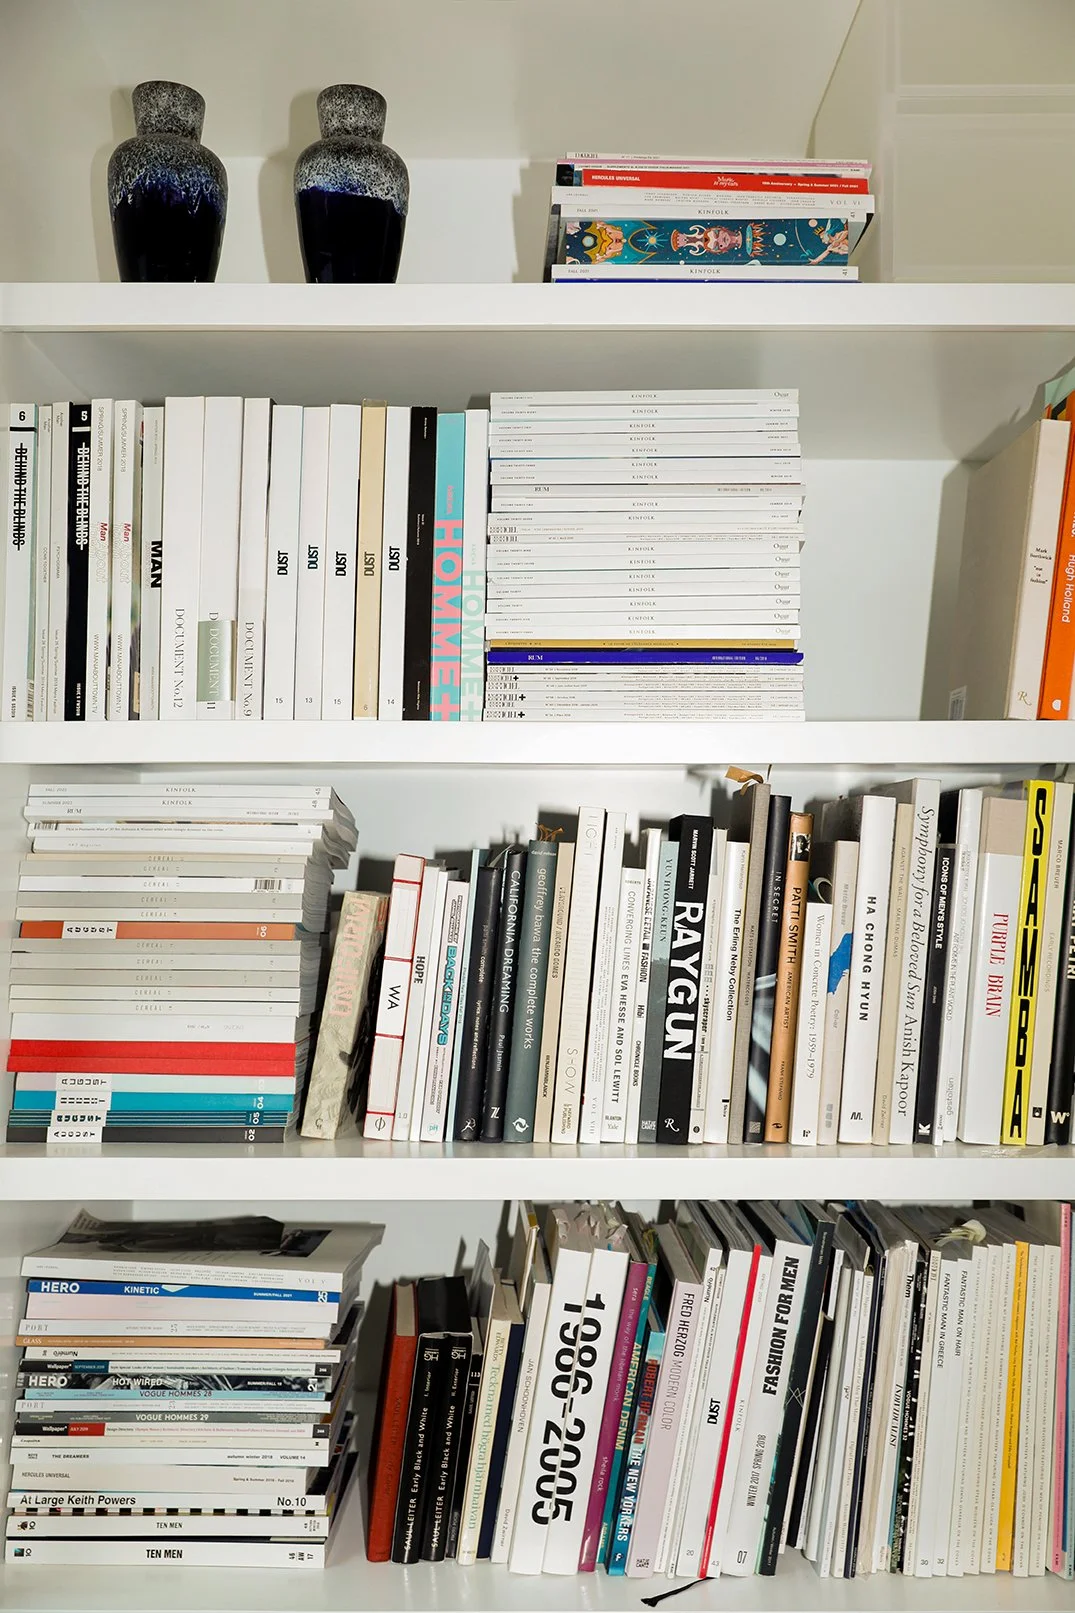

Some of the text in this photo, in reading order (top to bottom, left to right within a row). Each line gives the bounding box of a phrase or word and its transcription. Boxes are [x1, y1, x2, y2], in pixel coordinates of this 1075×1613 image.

[18, 411, 26, 421] 6
[81, 411, 88, 421] 5
[12, 447, 28, 546] BEHIND THE BLINDS
[75, 447, 90, 546] BEHIND THE BLINDS
[100, 522, 108, 541] Man
[150, 539, 163, 589] MAN
[277, 550, 288, 576] DUST
[307, 545, 319, 570] DUST
[335, 551, 347, 576] DUST
[363, 551, 375, 576] DUST
[388, 546, 400, 571] DUST
[1062, 554, 1075, 623] Hugh Holland
[173, 608, 185, 708] DOCUMENT No.12
[244, 622, 254, 689] DOCUMENT
[687, 828, 700, 891] MARVIN SCOTT JARRETT
[659, 859, 673, 942] YUN HYONG-KEUN
[771, 871, 783, 922] IN SECRET
[935, 855, 950, 950] ICONS OF MEN'S STYLE
[259, 926, 267, 937] 06
[784, 885, 804, 965] PATTI SMITH
[815, 915, 825, 946] Women
[497, 868, 523, 1014] CALIFORNIA DREAMING
[523, 846, 548, 1050] geoffrey bawa the complete works
[814, 949, 820, 957] in
[412, 954, 426, 985] HOPE
[444, 946, 457, 992] BACK
[638, 952, 650, 983] FASHION
[726, 909, 742, 1021] The Erling Neby Collection
[859, 896, 877, 1021] HA CHONG HYUN
[895, 806, 935, 1117] Symphony for a Beloved Sun Anish Kapoor
[985, 913, 1009, 1017] PURPLE BRAIN
[663, 899, 706, 1062] RAYGUN
[811, 959, 822, 998] Concrete
[387, 985, 401, 1010] WA
[611, 891, 636, 1103] CONVERGING LINES EVA HESSE AND SOL LEWITT
[635, 1003, 646, 1020] Hibi
[781, 970, 793, 1030] AMERICAN ARTIST
[438, 1002, 451, 1046] DAYS
[807, 1000, 819, 1030] Poetry:
[257, 1096, 264, 1109] 04
[248, 1128, 256, 1141] 02
[41, 1282, 80, 1293] HERO
[124, 1286, 160, 1295] KINETIC
[905, 1274, 915, 1298] Them
[942, 1273, 951, 1311] FANTASTIC
[673, 1293, 695, 1358] FRED HERZOG
[760, 1254, 801, 1398] FASHION FOR MEN
[939, 1331, 946, 1340] IN
[937, 1338, 945, 1368] GREECE
[28, 1375, 68, 1387] HERO
[112, 1378, 163, 1386] HOT WIRED
[517, 1358, 534, 1433] JAN SCHOONHOVEN
[660, 1359, 682, 1432] MODERN COLOR
[615, 1343, 641, 1451] AMERICAN DENIM
[707, 1398, 721, 1425] DUST
[134, 1413, 210, 1422] VOGUE HOMMES 29
[418, 1407, 428, 1431] White
[413, 1450, 423, 1471] Black
[745, 1432, 768, 1508] WINTER 2017 SPRING 2018
[410, 1473, 421, 1493] Early
[617, 1447, 643, 1542] THE NEW YORKERS
[20, 1495, 136, 1507] At Large Keith Powers
[277, 1497, 307, 1507] No.10
[146, 1548, 183, 1559] TEN MEN
